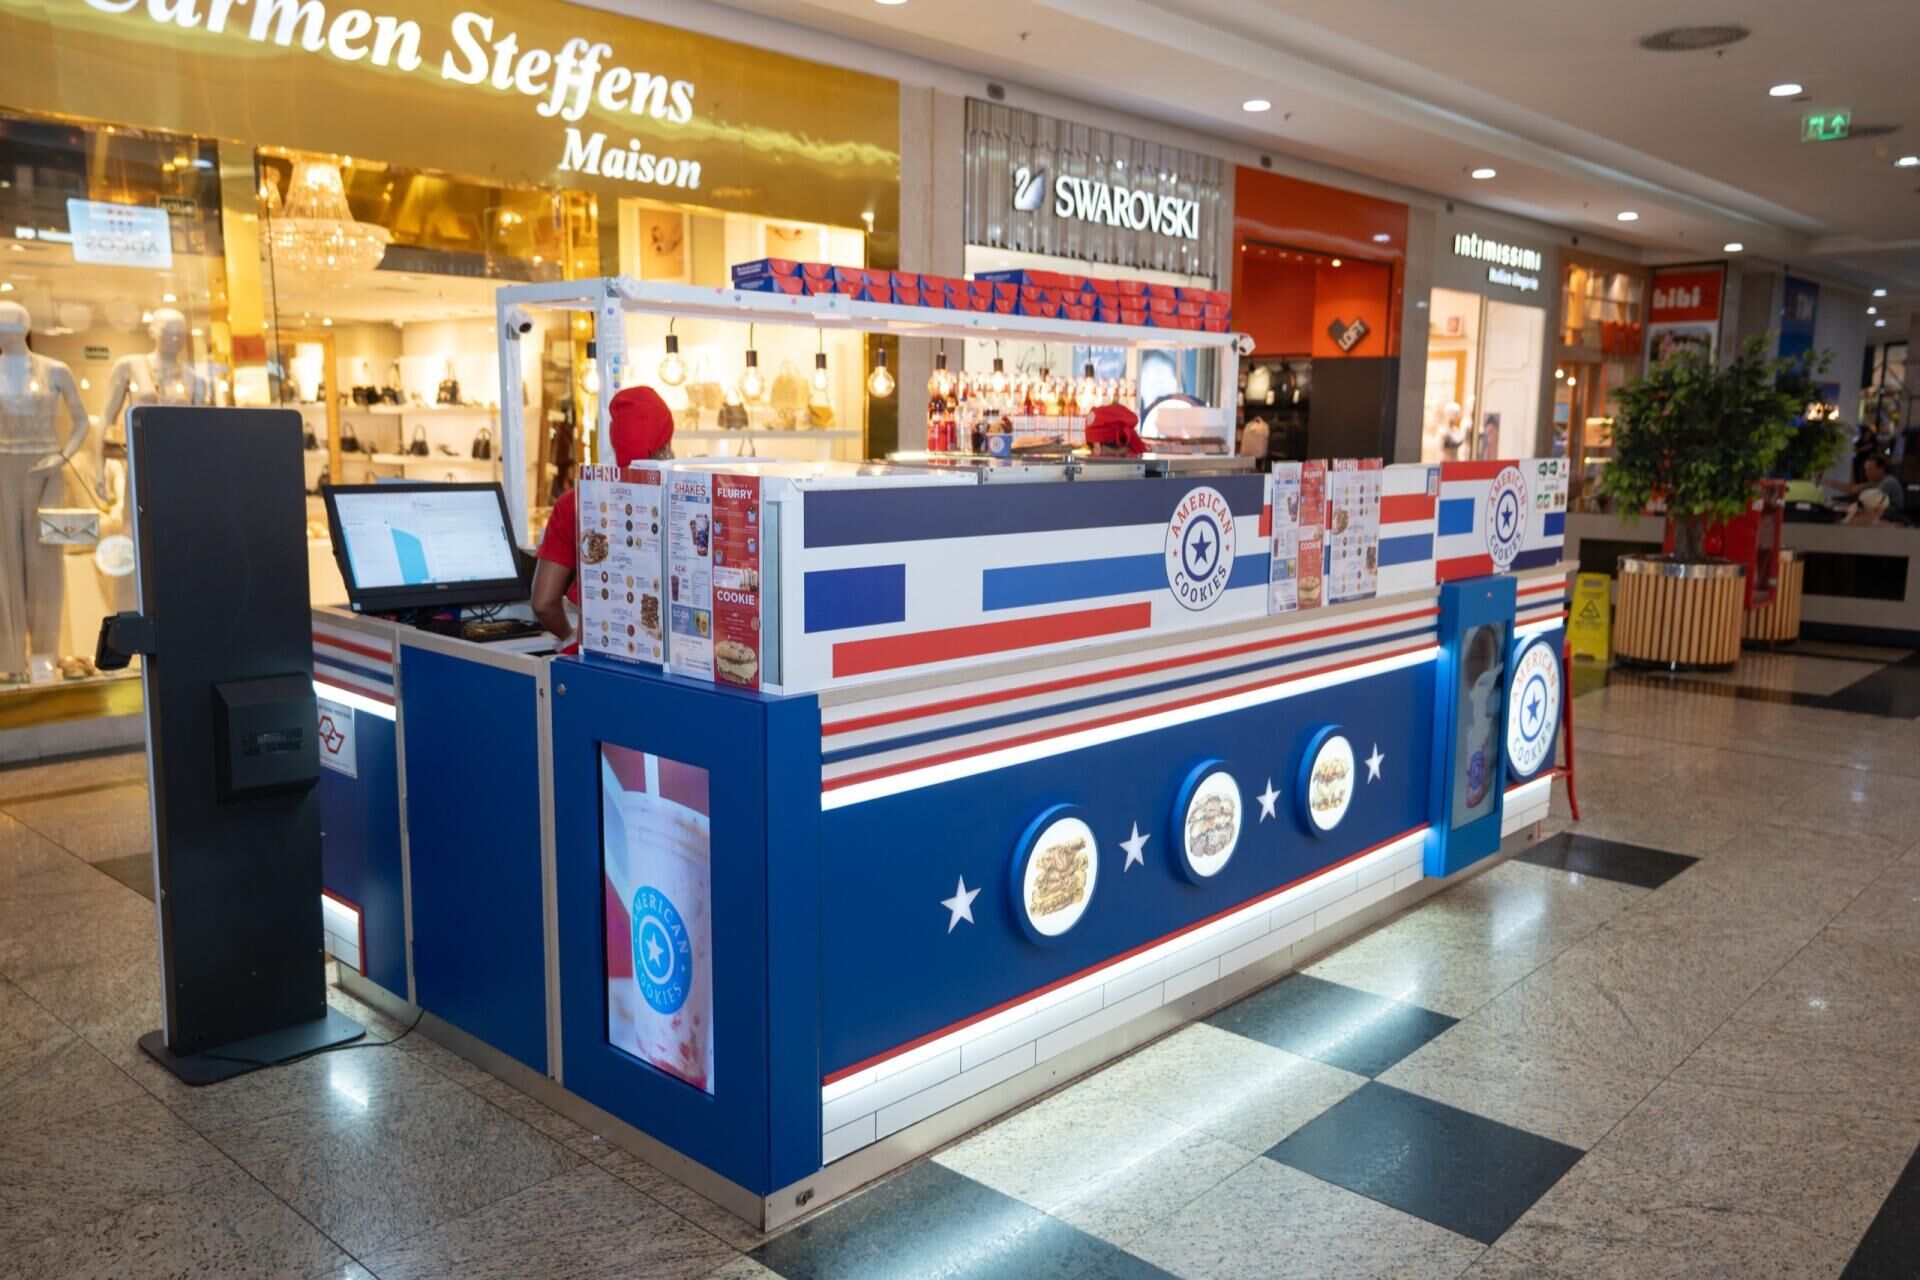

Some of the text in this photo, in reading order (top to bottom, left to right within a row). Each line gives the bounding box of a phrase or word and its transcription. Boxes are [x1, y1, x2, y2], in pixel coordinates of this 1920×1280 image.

[80, 0, 695, 124] armen Steffens
[560, 128, 701, 190] Maison
[1055, 174, 1199, 240] SWAROVSKI
[583, 465, 621, 482] MENU
[674, 483, 706, 496] SHAKES
[717, 487, 753, 499] FLURRY
[1490, 471, 1527, 507] AMERICAN
[1171, 492, 1233, 538] AMERICAN
[1490, 531, 1522, 561] COOKIES
[716, 590, 755, 605] COOKIE
[1174, 564, 1227, 603] COOKIES
[1512, 651, 1558, 703] AMERICAN
[1513, 720, 1553, 765] COOKIES
